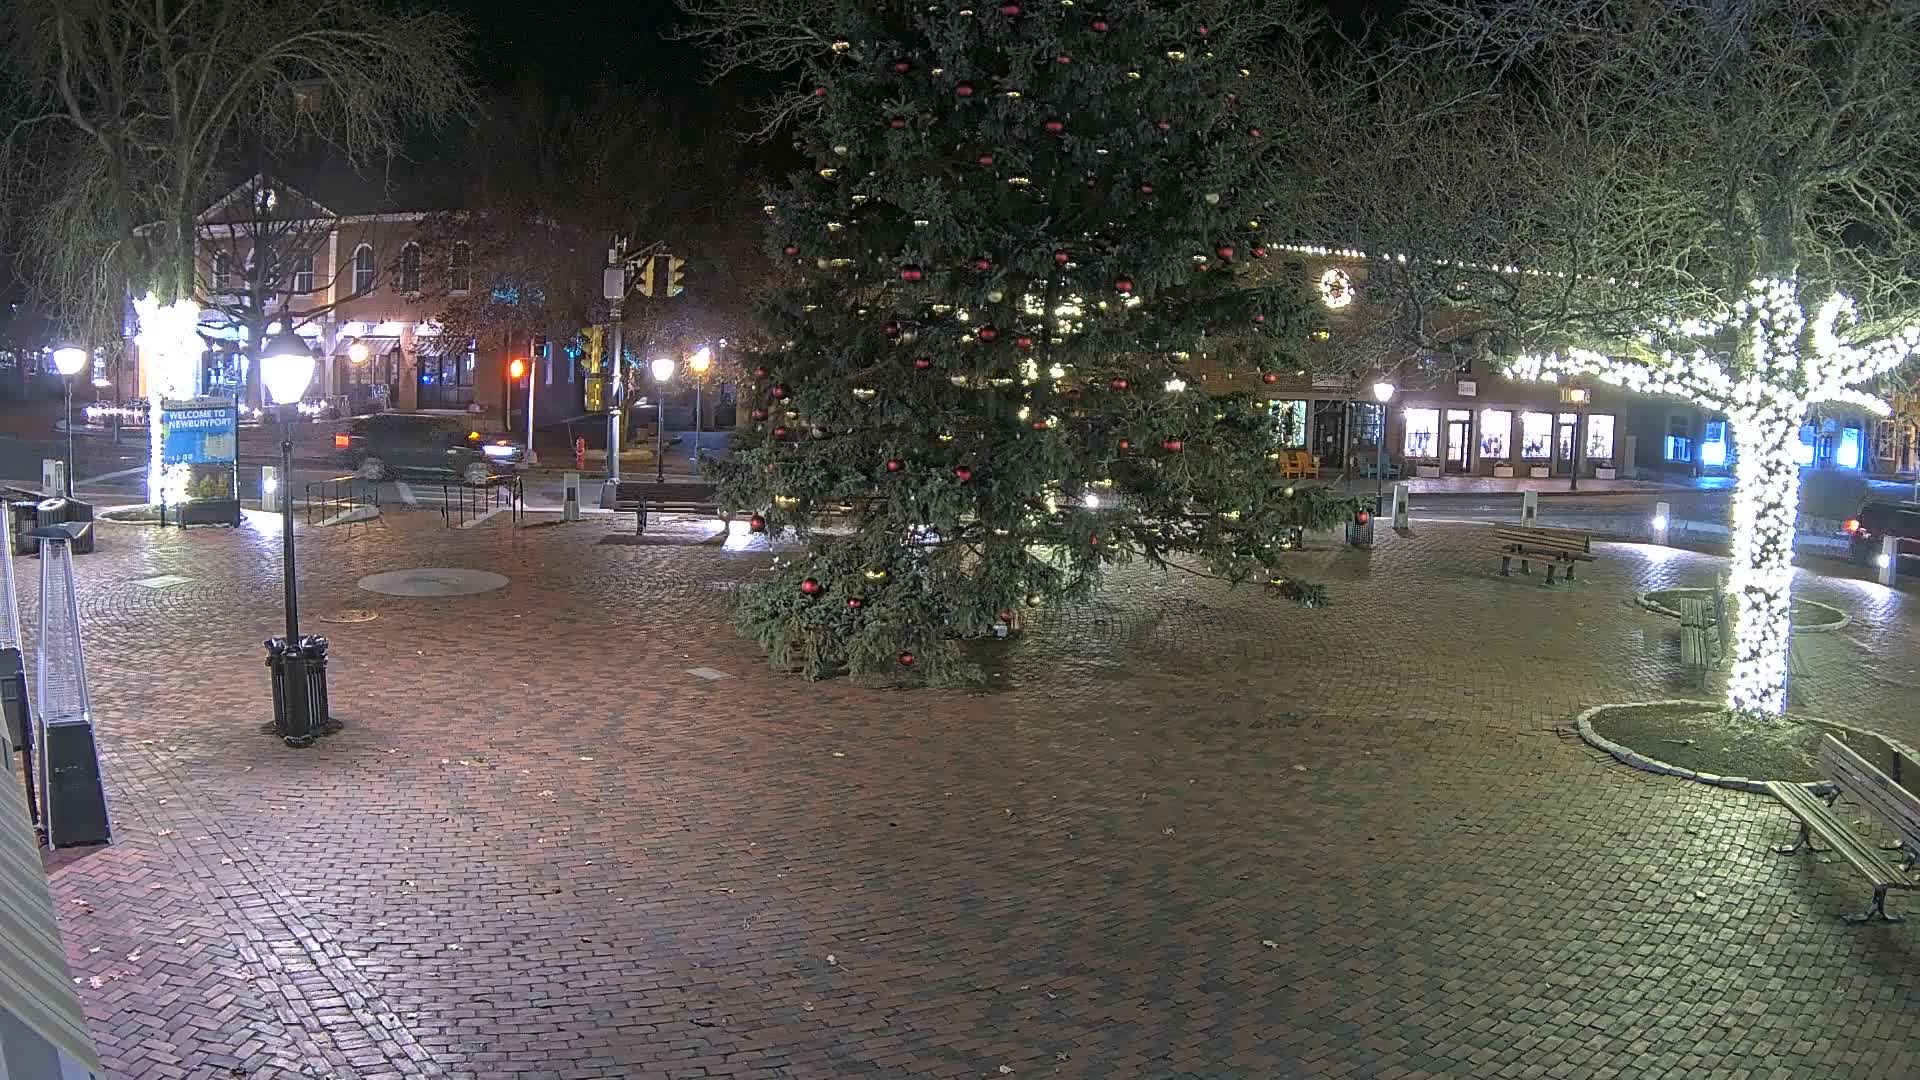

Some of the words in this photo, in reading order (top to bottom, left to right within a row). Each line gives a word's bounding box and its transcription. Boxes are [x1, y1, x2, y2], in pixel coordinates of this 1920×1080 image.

[169, 410, 212, 420] WELCOME
[214, 409, 226, 417] TO
[168, 418, 232, 429] NEWBURYPORT
